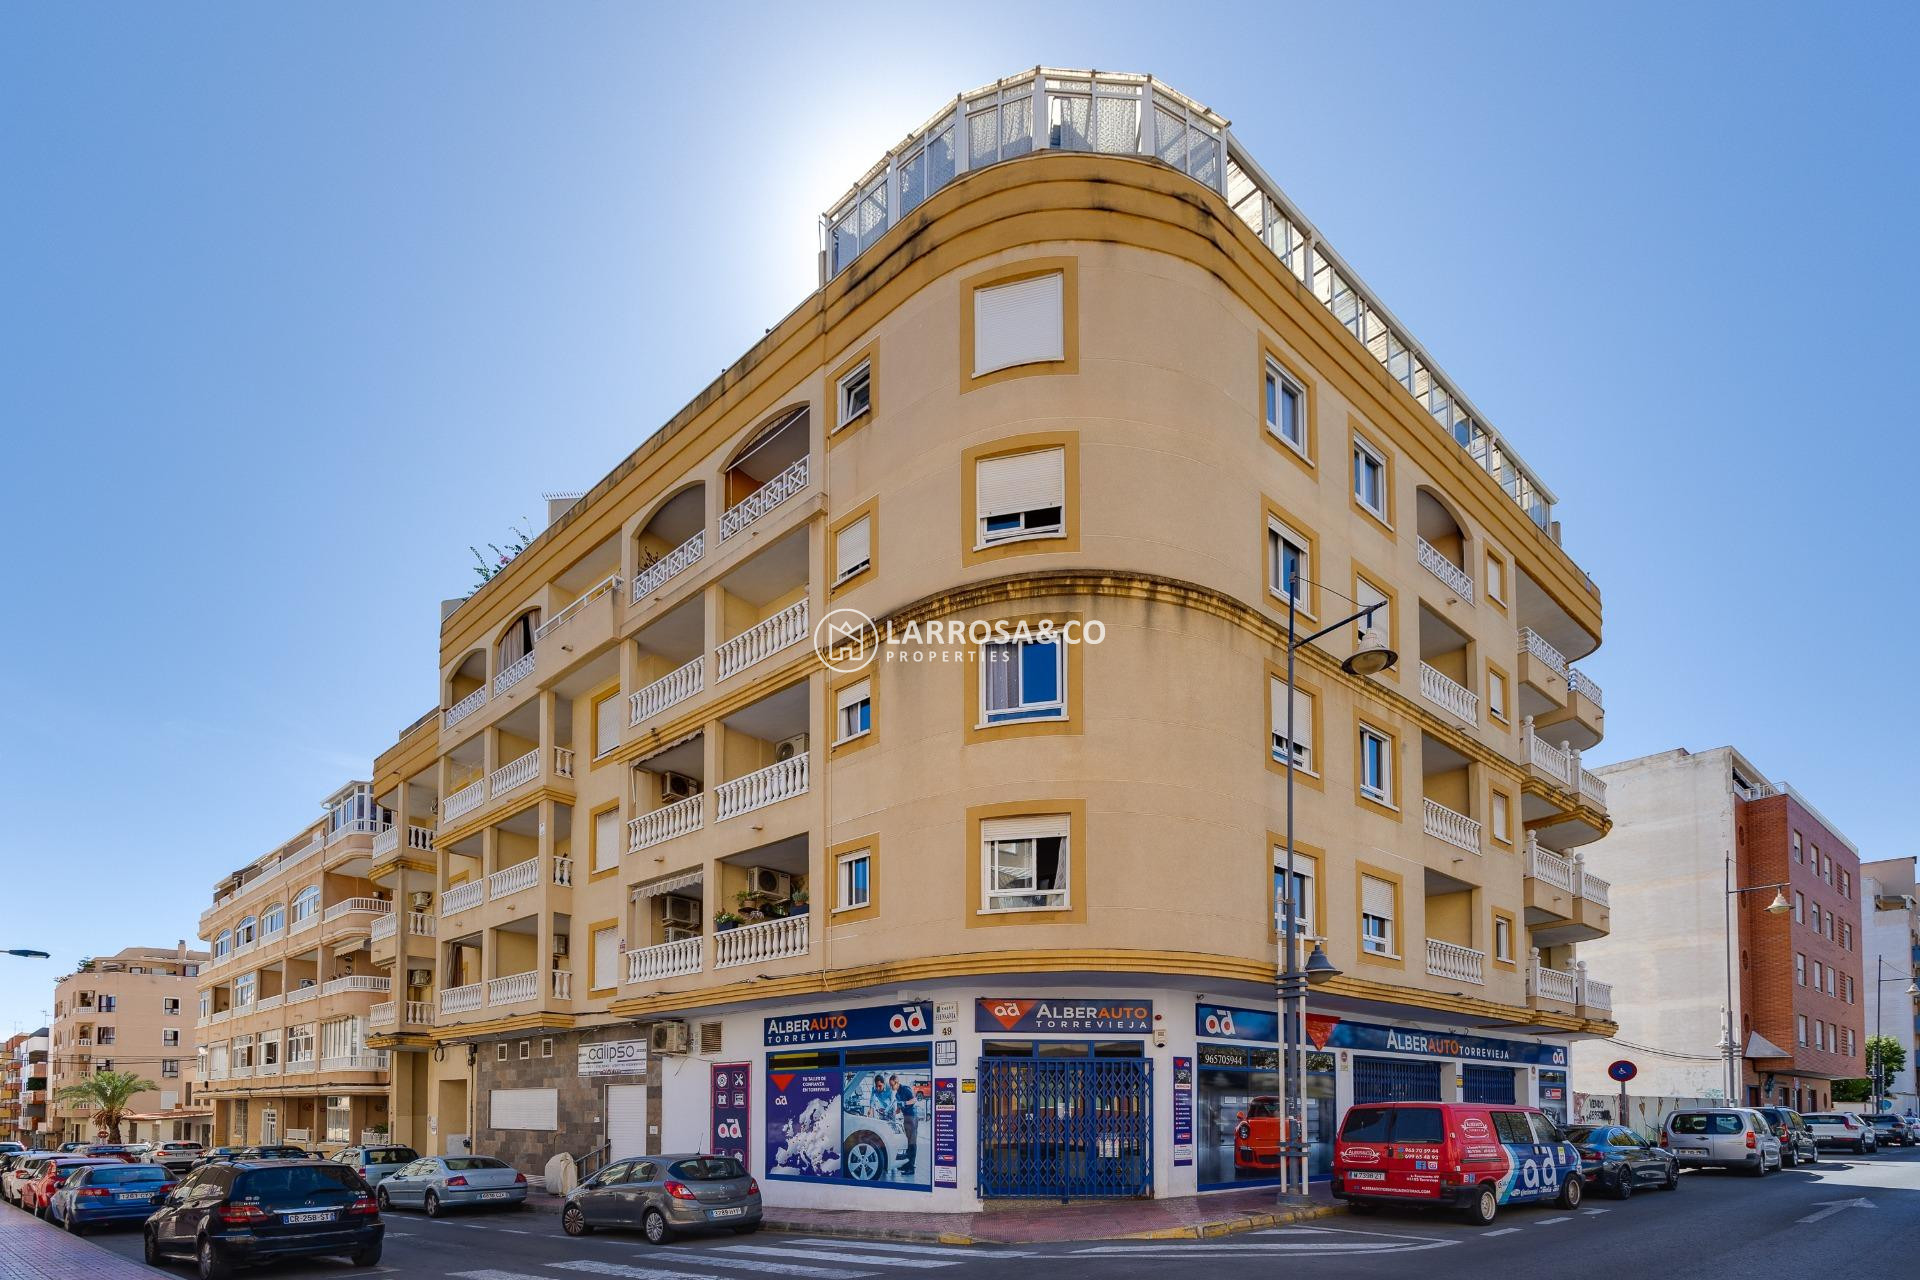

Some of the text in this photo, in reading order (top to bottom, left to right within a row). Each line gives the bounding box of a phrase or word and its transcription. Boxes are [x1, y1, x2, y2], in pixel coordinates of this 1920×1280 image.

[1036, 1003, 1148, 1019] ALBERAUTO
[767, 1015, 848, 1035] ALBERAUTO
[942, 1027, 952, 1036] 49
[1036, 1020, 1148, 1029] TORREVIEJA
[767, 1030, 848, 1044] TORREVIEJA
[1386, 1028, 1510, 1060] ALBERAUTO TORREVIEJA
[588, 1044, 635, 1062] calipso
[1204, 1054, 1242, 1065] 965705944
